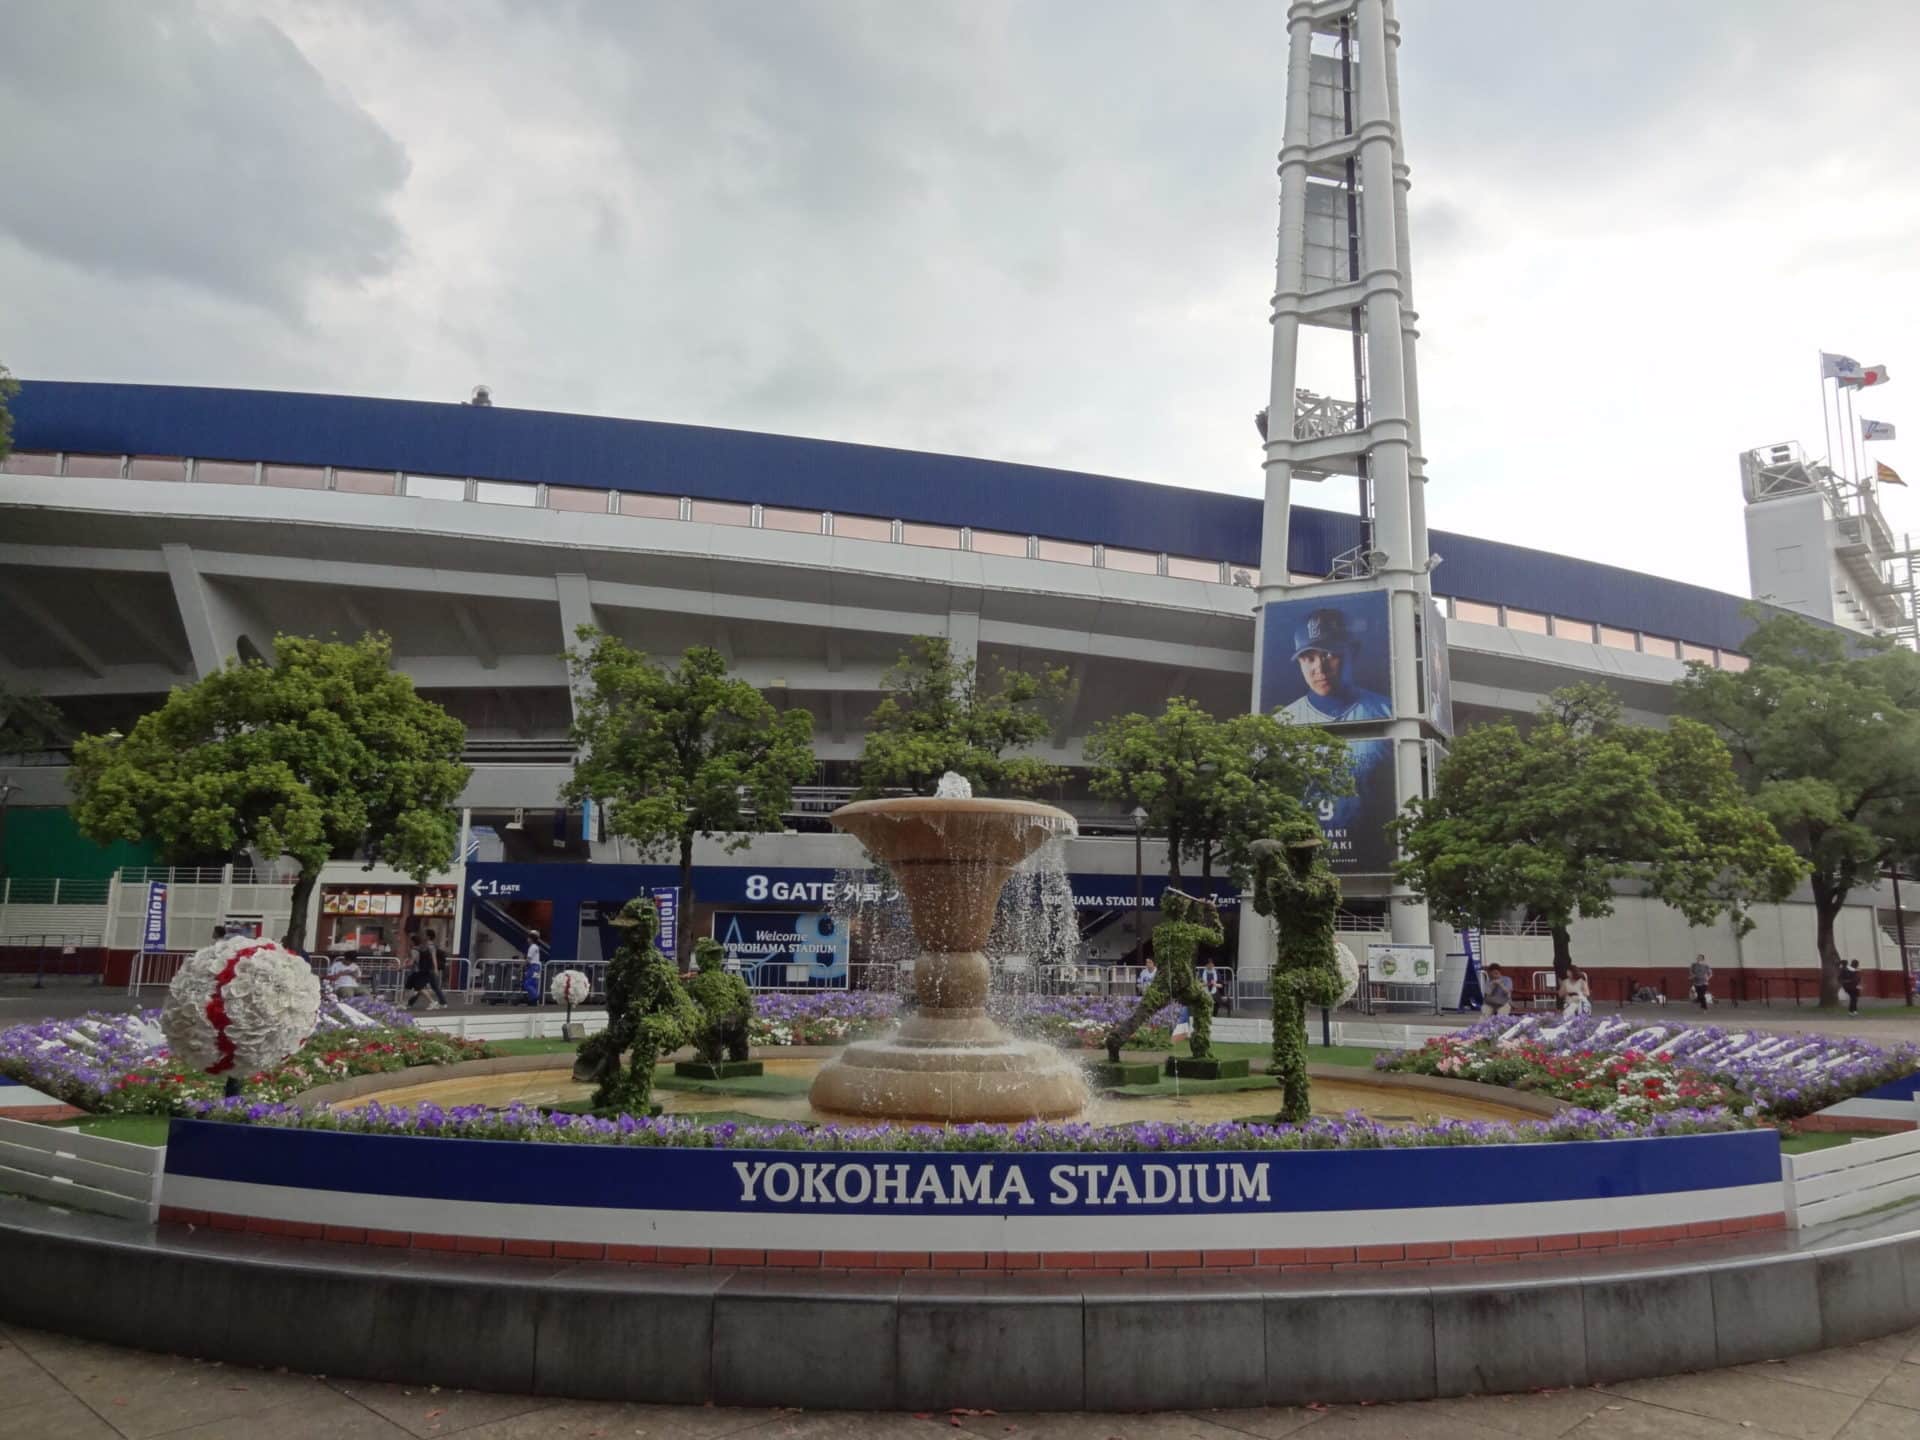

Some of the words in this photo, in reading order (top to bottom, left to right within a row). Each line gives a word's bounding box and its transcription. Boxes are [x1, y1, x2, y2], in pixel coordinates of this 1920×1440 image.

[488, 880, 499, 895] 1
[500, 884, 521, 892] GATE
[745, 875, 769, 901] 8
[772, 882, 837, 901] GATE
[756, 930, 809, 942] Welcome
[723, 943, 786, 953] YOKOHAMA
[788, 943, 837, 953] STADIUM
[732, 1161, 1035, 1205] YOKOHAMA
[1049, 1163, 1272, 1205] STADIUM
